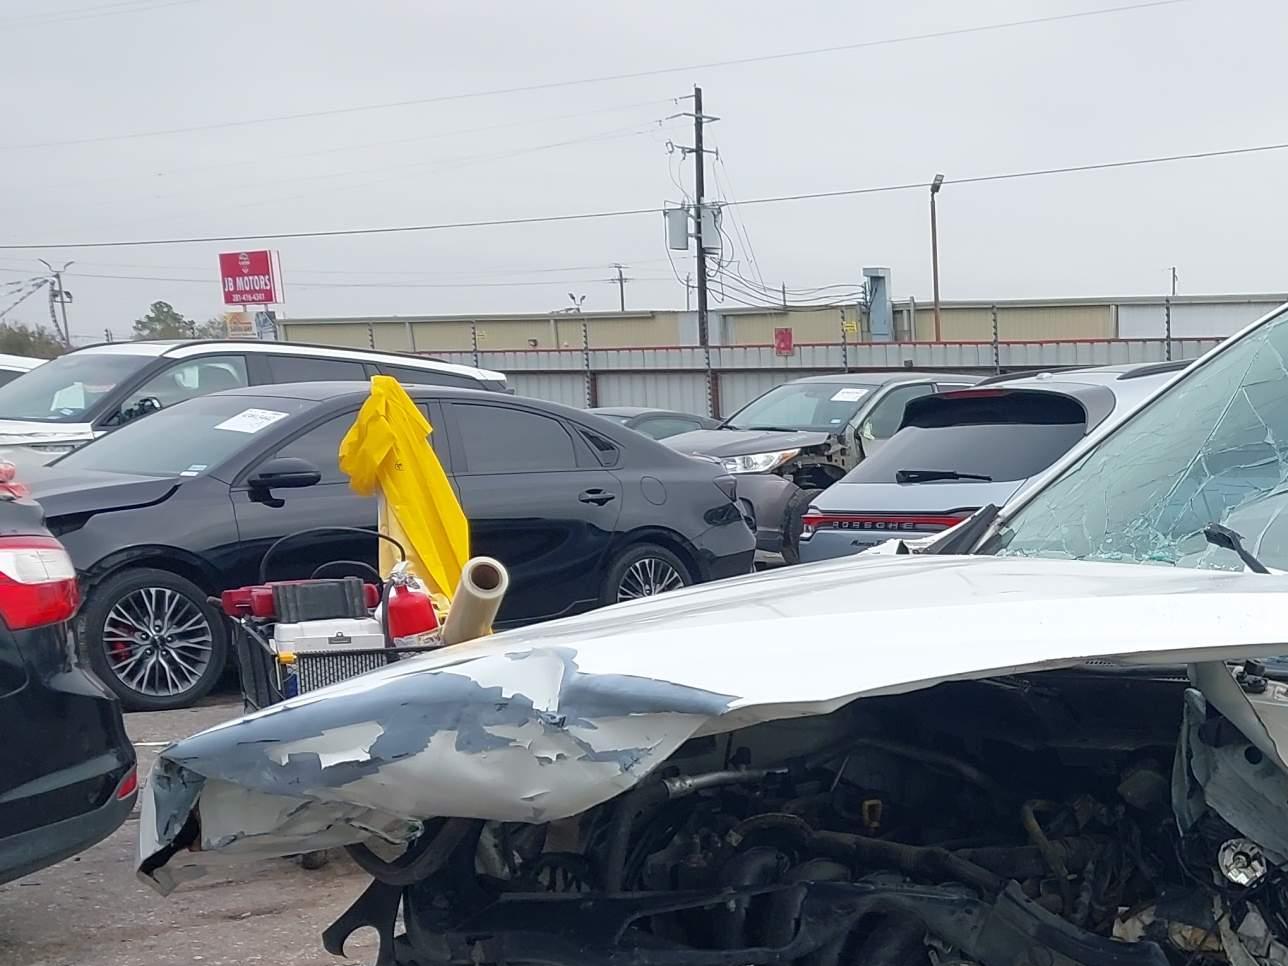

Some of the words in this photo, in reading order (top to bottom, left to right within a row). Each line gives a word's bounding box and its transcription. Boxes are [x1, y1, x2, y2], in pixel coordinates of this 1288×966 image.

[224, 276, 234, 292] JB
[236, 275, 270, 290] MOTORS
[832, 521, 914, 530] PORSCHE
